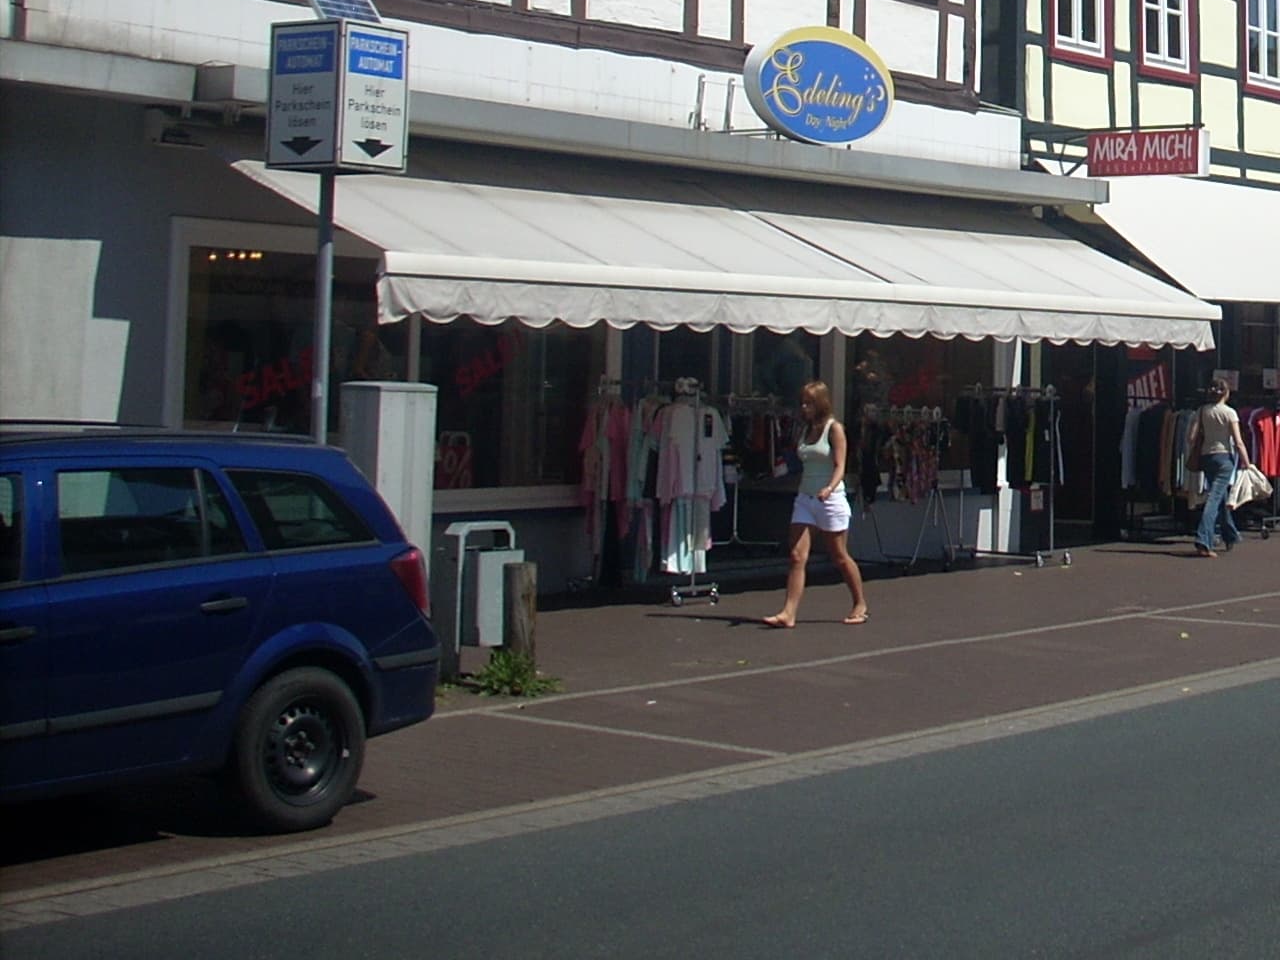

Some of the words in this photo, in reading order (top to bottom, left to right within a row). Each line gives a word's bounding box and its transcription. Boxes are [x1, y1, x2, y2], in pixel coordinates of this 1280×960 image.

[348, 98, 401, 116] Parkschein
[1093, 134, 1137, 163] MIRA
[1142, 133, 1192, 161] MICHI
